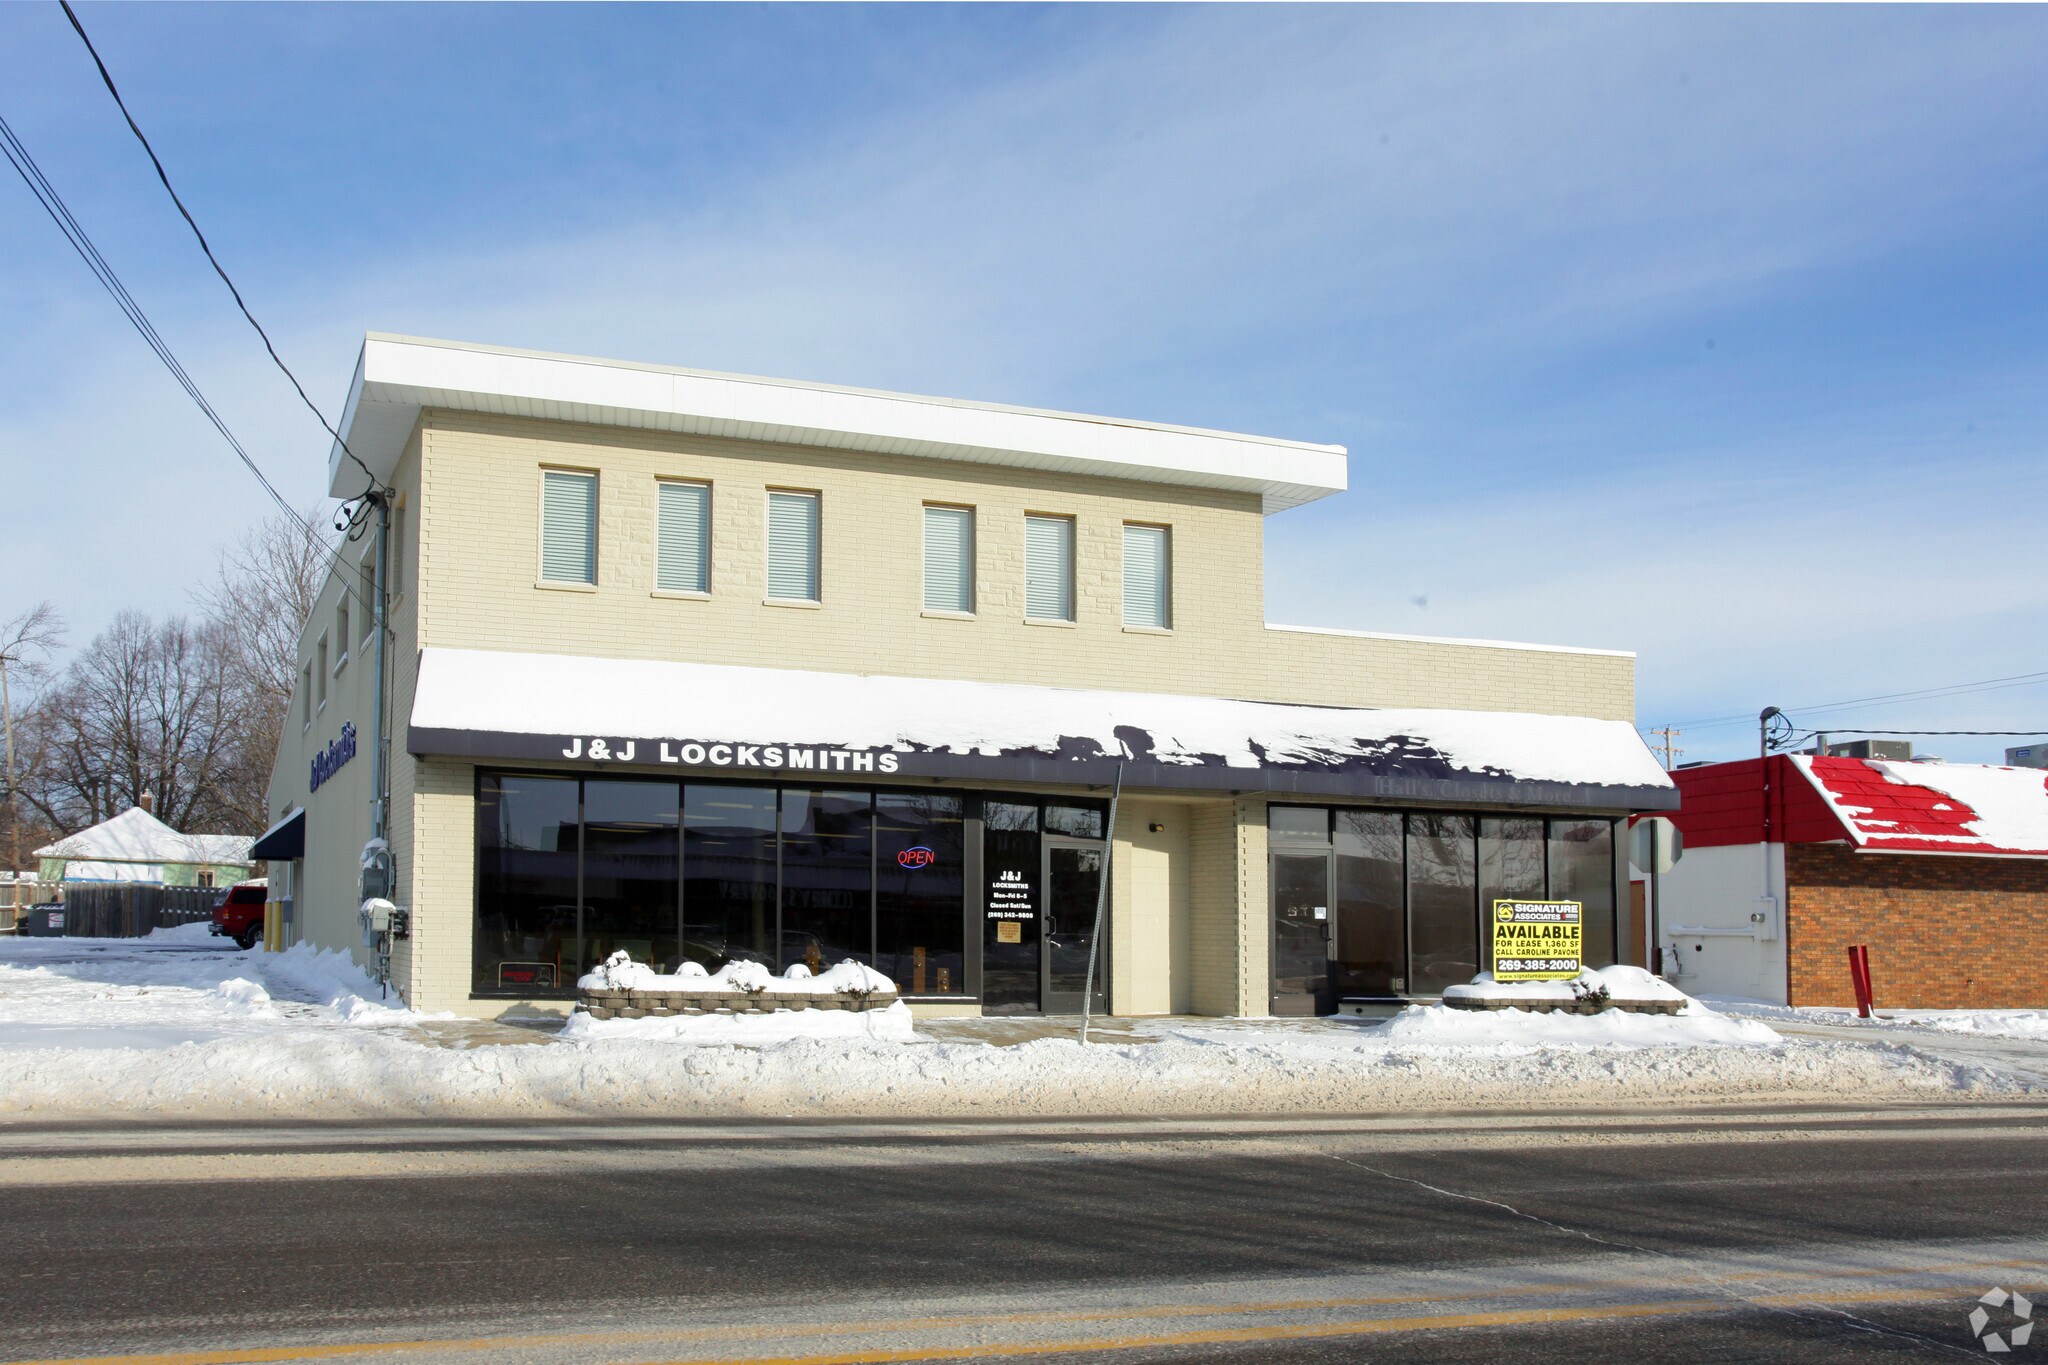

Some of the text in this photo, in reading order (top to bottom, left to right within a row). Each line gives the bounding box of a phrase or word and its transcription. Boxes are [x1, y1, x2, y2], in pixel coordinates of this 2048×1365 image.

[562, 738, 899, 773] J&J LOCKSMITHS
[897, 850, 935, 864] OPEN
[1000, 870, 1021, 881] J&J
[1514, 904, 1578, 913] SIGNATURE
[1496, 925, 1580, 939] AVAILABLE
[1498, 960, 1577, 971] 269-385-2000
